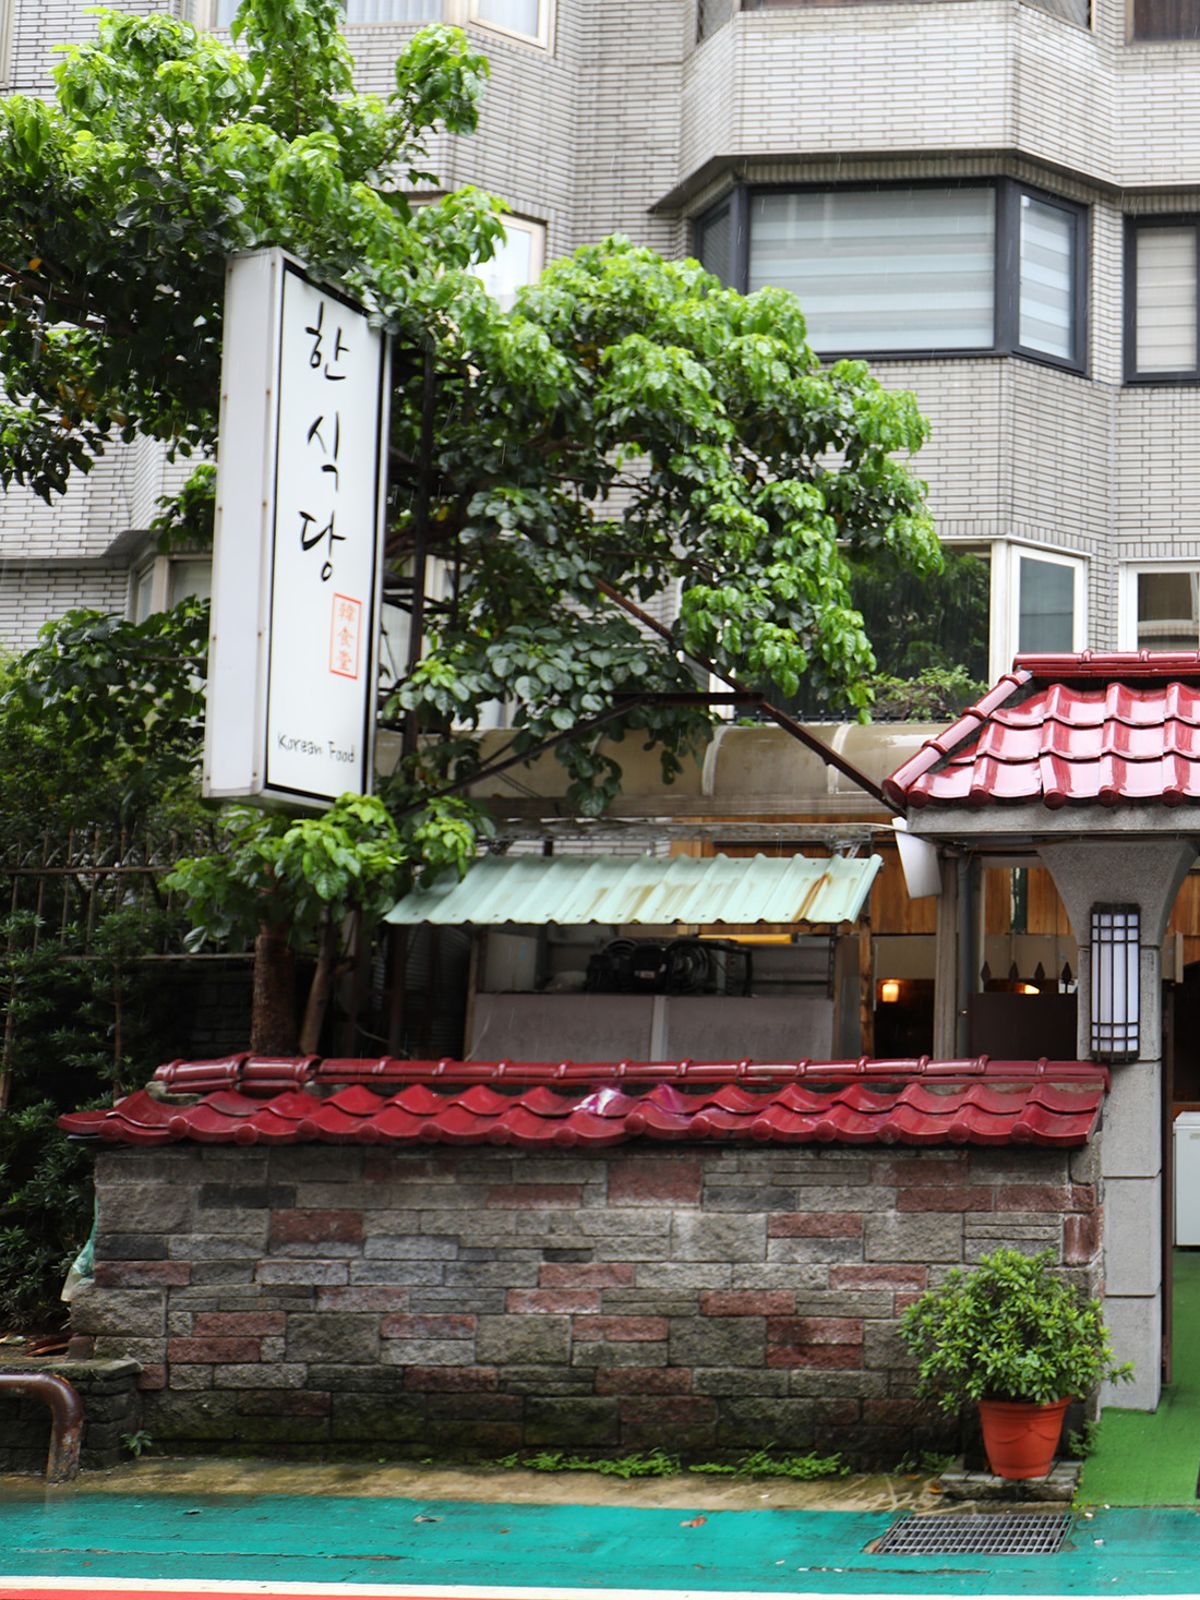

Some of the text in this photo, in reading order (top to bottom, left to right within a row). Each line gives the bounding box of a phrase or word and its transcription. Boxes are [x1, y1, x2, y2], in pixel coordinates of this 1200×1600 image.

[299, 301, 350, 582] 한식당
[277, 732, 355, 763] Korean Food
